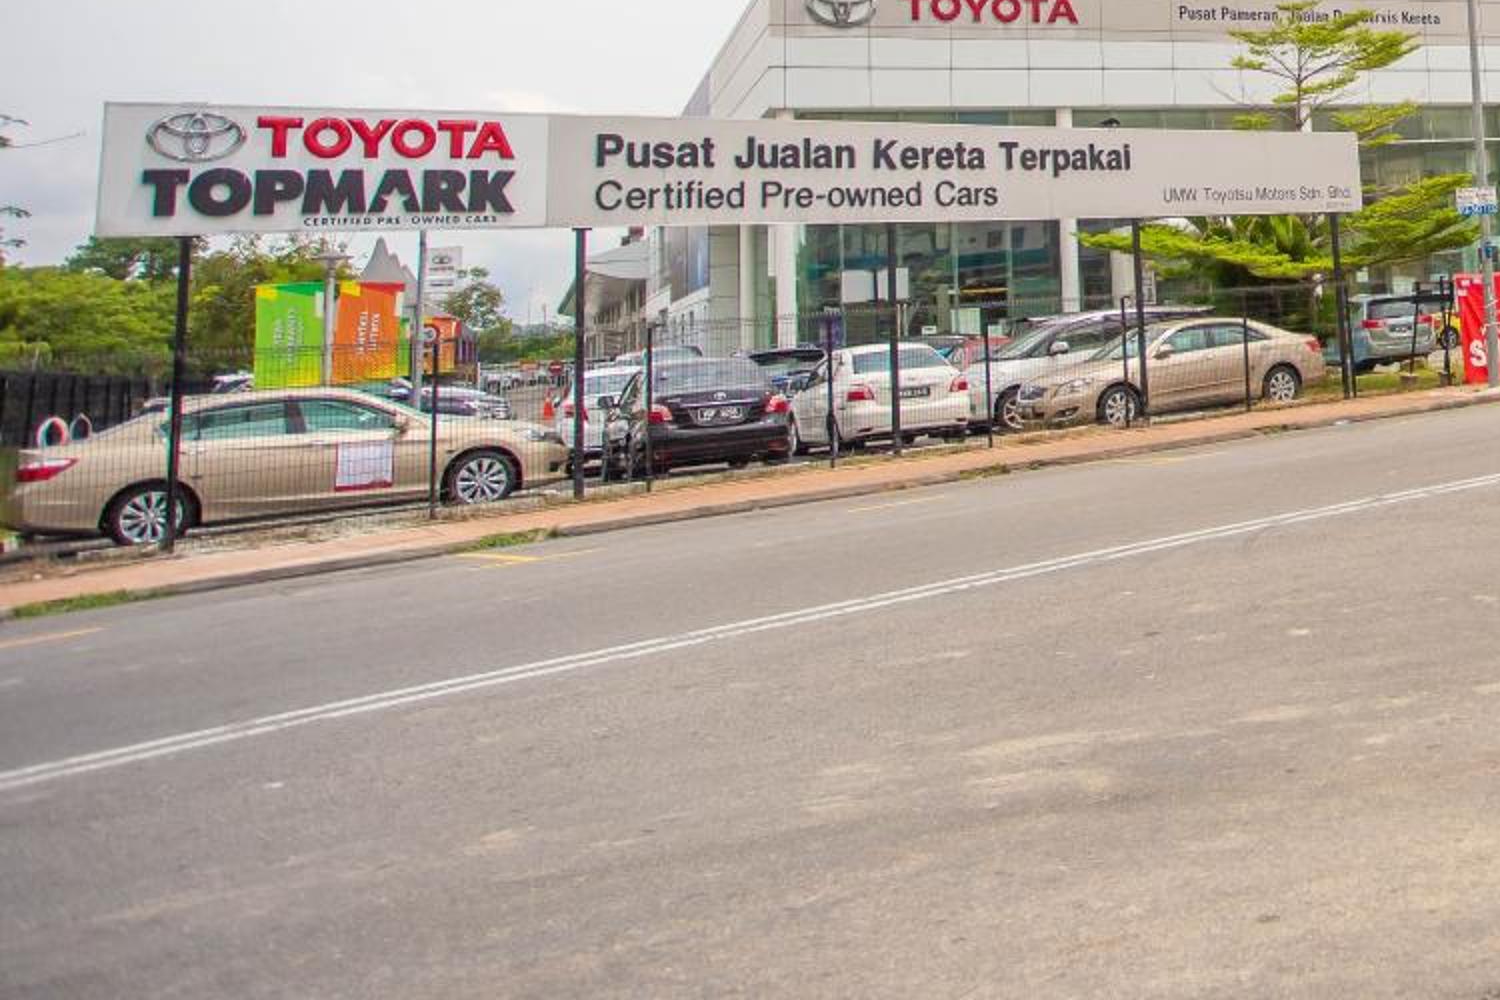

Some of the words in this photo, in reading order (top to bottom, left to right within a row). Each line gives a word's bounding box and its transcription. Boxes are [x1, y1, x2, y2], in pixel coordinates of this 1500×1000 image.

[1178, 6, 1217, 21] Pusat
[1401, 11, 1441, 25] Kereta
[257, 115, 515, 159] TOYOTA
[595, 133, 716, 169] Pusat
[734, 136, 857, 169] Jualan
[872, 139, 986, 170] Kereta
[998, 141, 1132, 178] Terpakai
[142, 168, 515, 217] TOPMARK
[595, 180, 746, 211] Certified
[761, 181, 922, 209] Pre-owned
[934, 181, 999, 207] Cars
[1163, 188, 1198, 203] UMW
[303, 216, 371, 227] CERTIFIED
